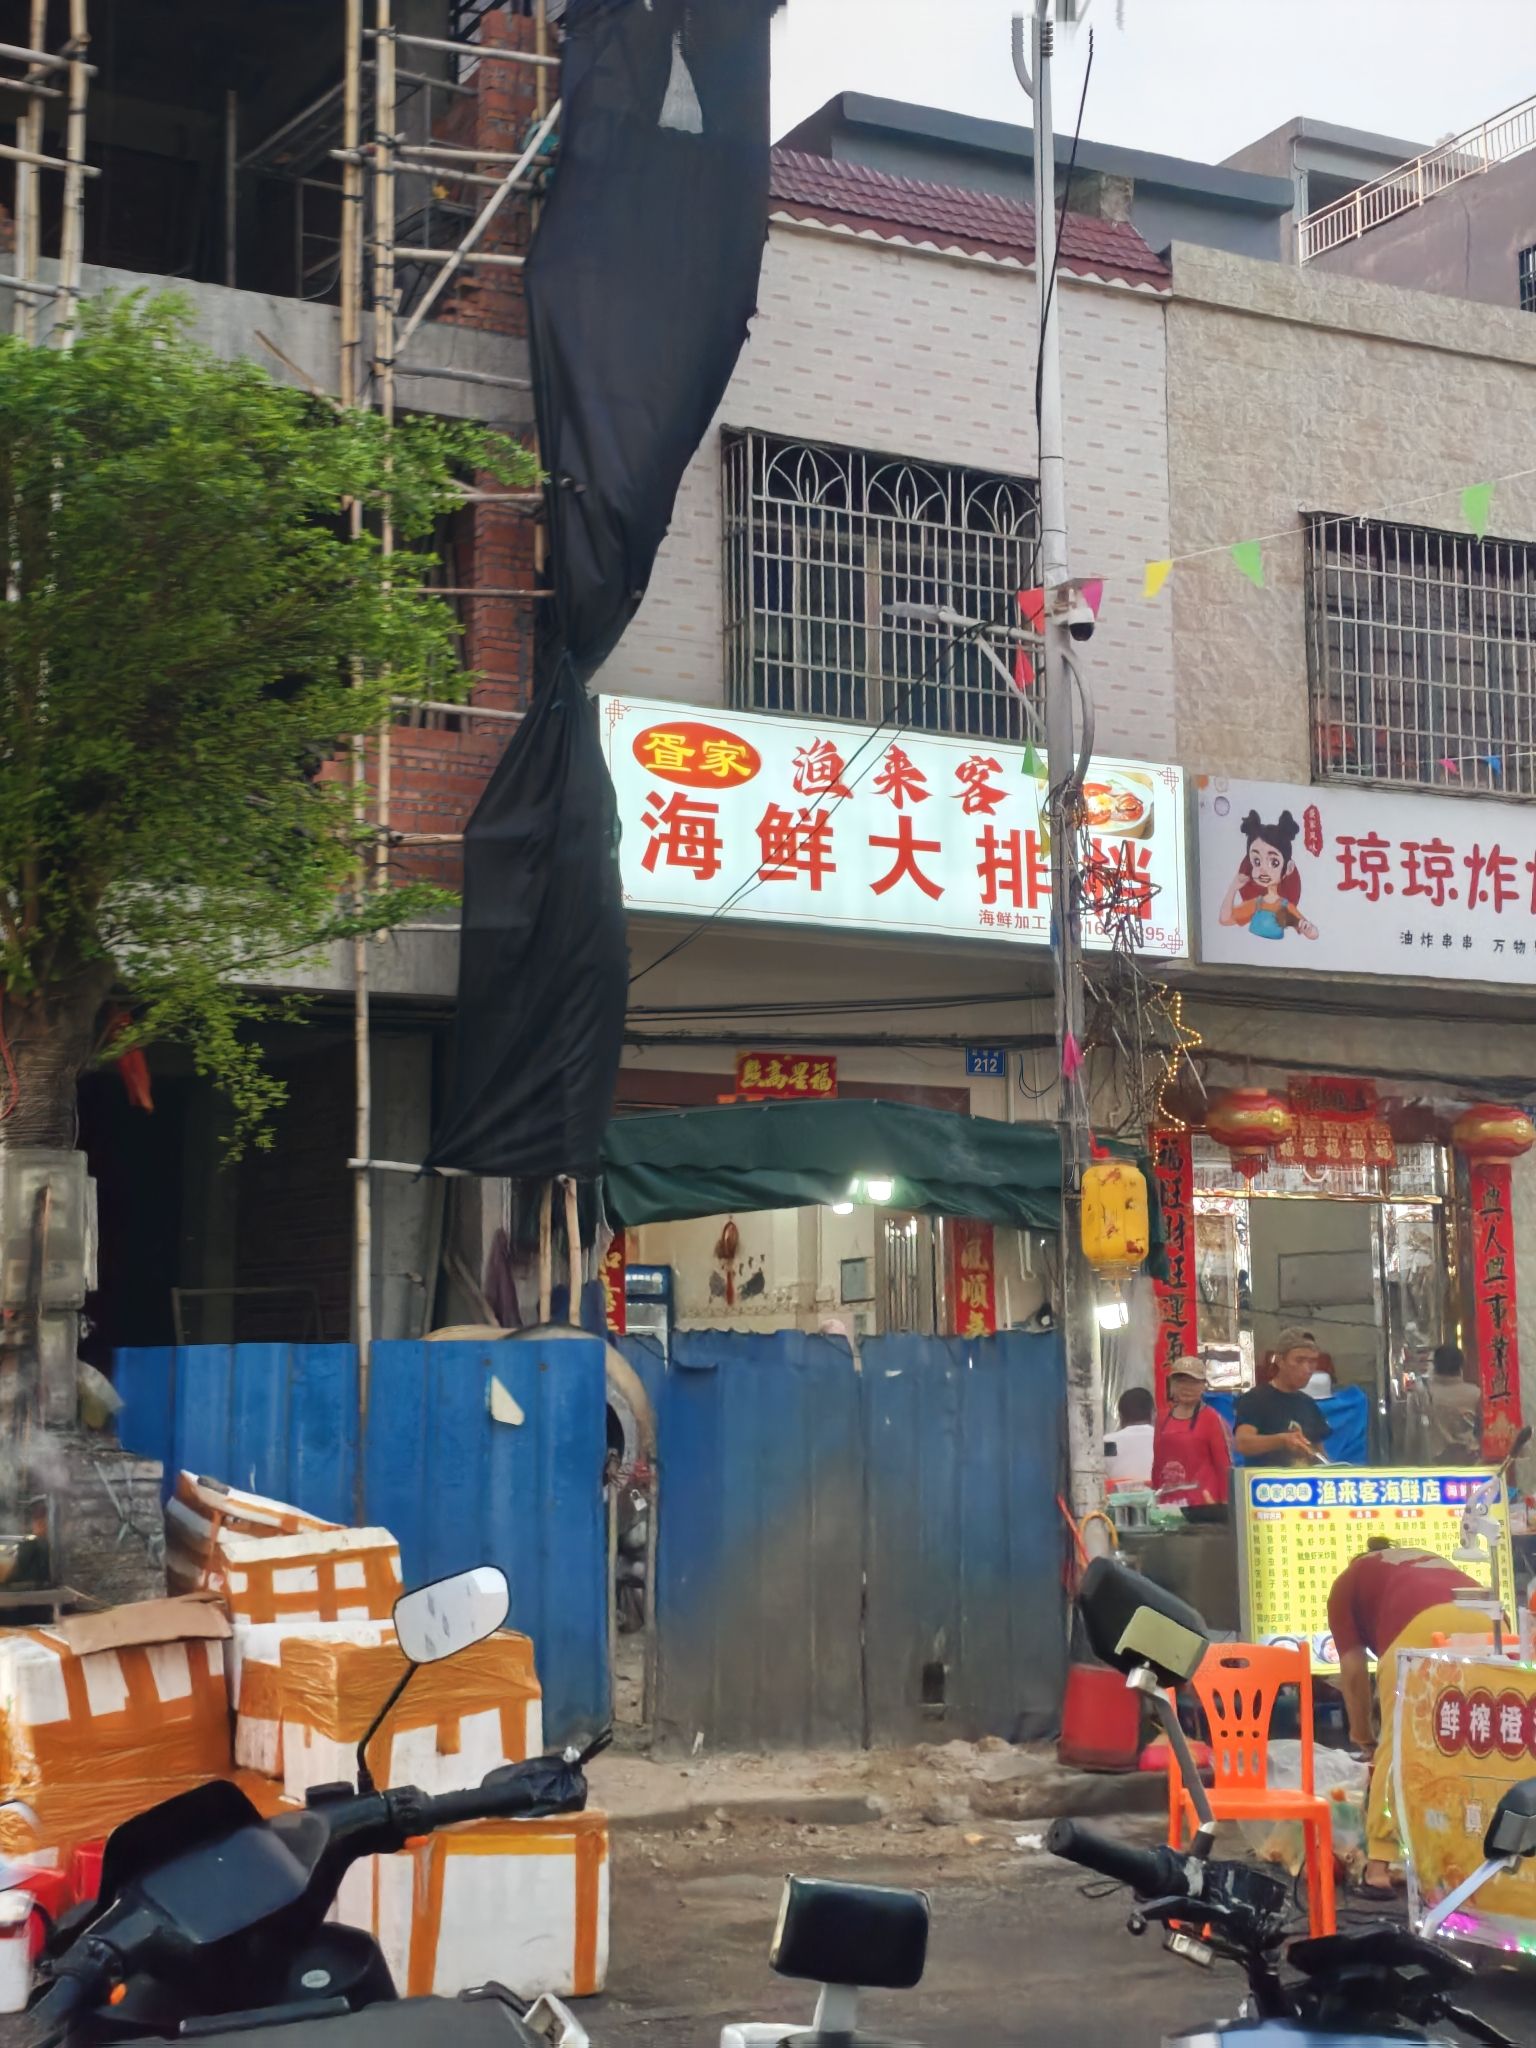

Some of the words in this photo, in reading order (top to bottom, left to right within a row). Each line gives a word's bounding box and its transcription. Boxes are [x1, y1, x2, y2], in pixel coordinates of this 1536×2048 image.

[791, 736, 1012, 816] 渔来客
[1335, 831, 1536, 915] 琼琼炸
[978, 909, 1048, 930] 海鲜加工
[1400, 929, 1473, 949] 油炸串串
[1493, 938, 1536, 955] 万物
[974, 1057, 998, 1073] 212
[1317, 1479, 1441, 1504] 渔来客海鲜店
[1440, 1701, 1536, 1745] 鲜榨橙
